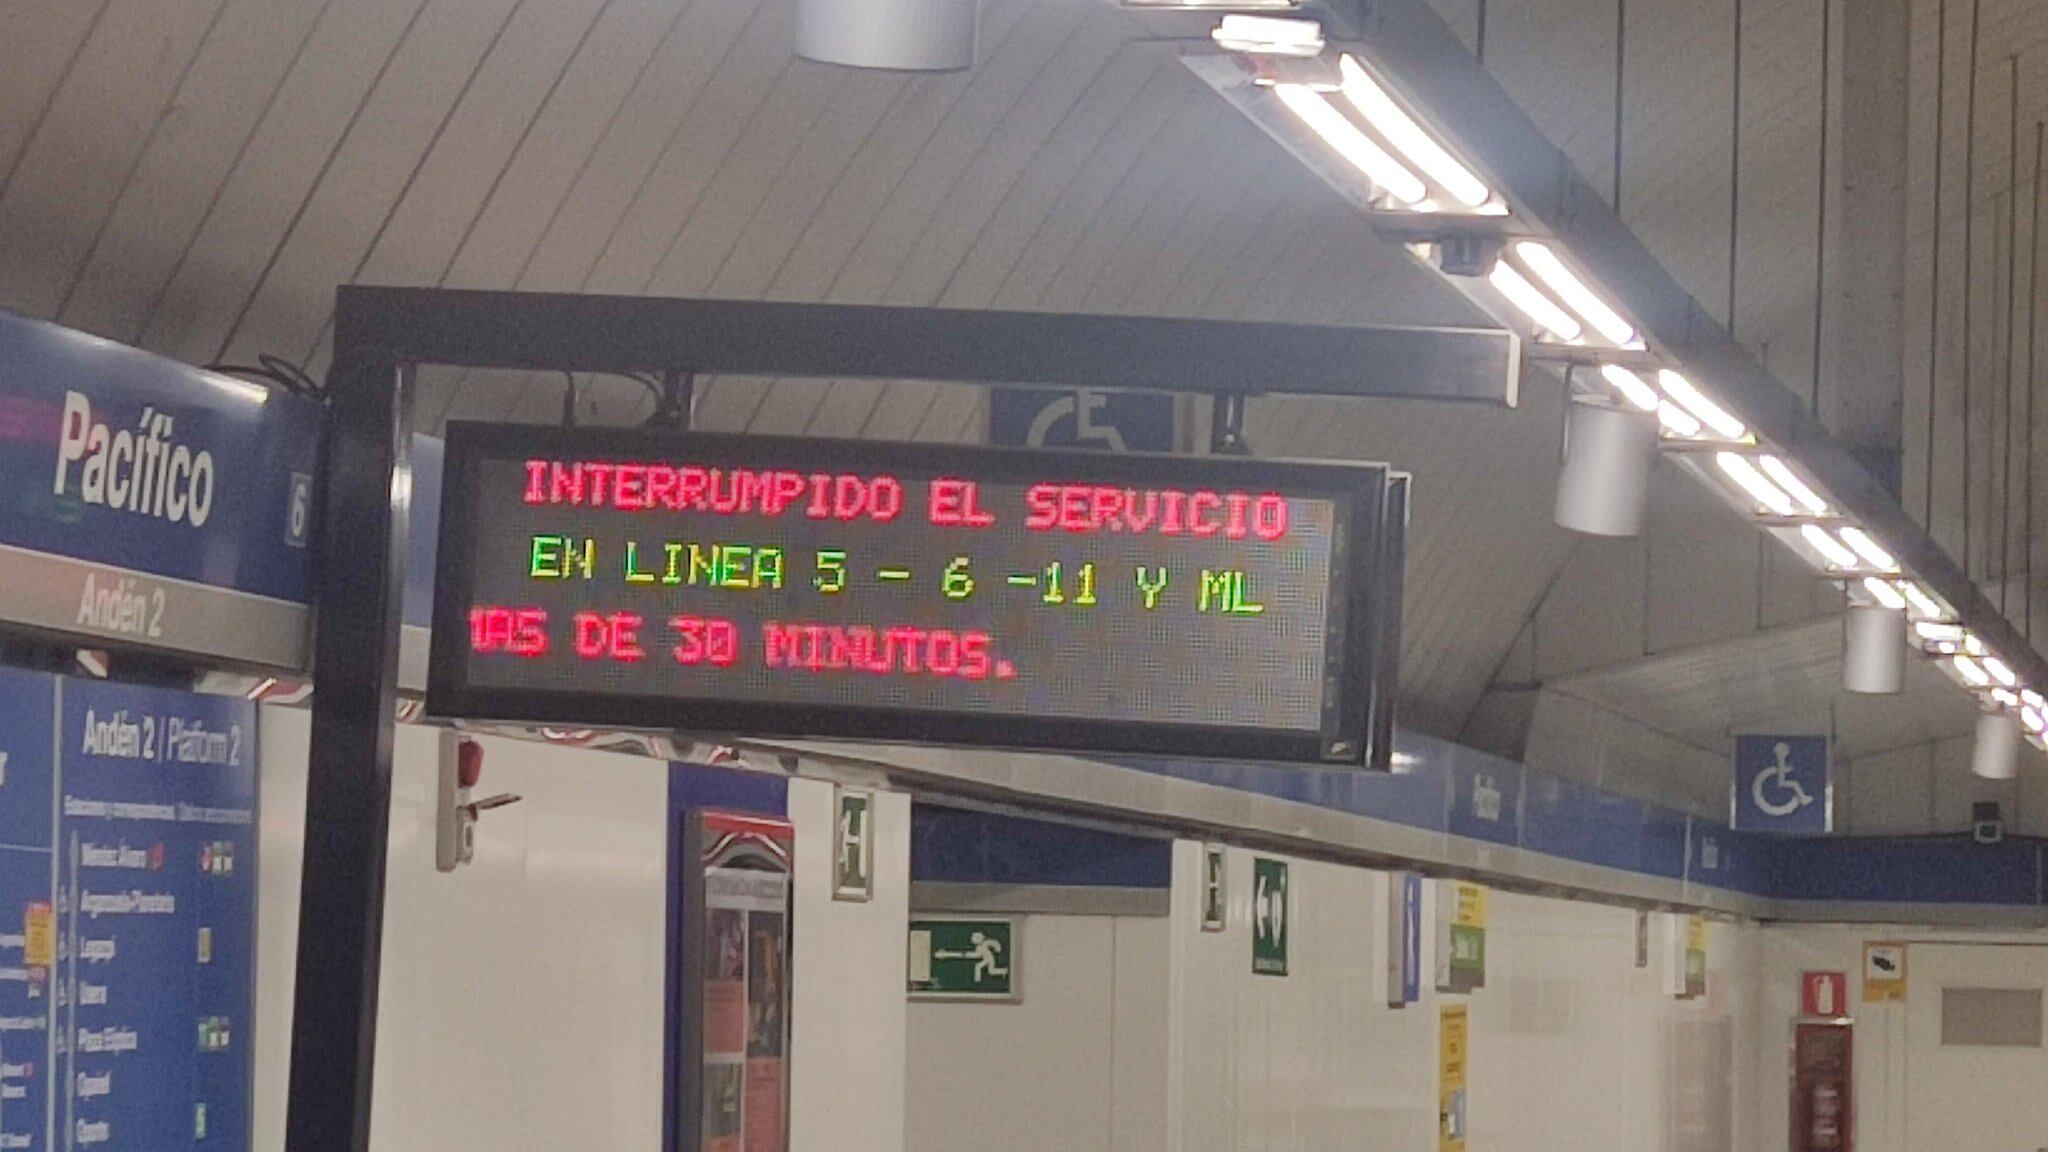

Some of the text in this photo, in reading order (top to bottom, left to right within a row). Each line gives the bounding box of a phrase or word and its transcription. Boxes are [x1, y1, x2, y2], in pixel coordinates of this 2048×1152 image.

[53, 390, 214, 527] Pacífico
[292, 482, 306, 537] 6
[524, 459, 1289, 541] INTERRUMPIDO EL SERVICIO
[76, 573, 166, 638] Andén 2
[530, 536, 596, 580] EN
[625, 541, 784, 589] LINEA
[812, 550, 848, 593] 5
[942, 556, 976, 599] 6
[1136, 566, 1169, 610] Y
[1198, 569, 1265, 613] ML
[573, 611, 645, 662] DE
[671, 614, 740, 667] 30
[763, 620, 1018, 681] MINUTOS.
